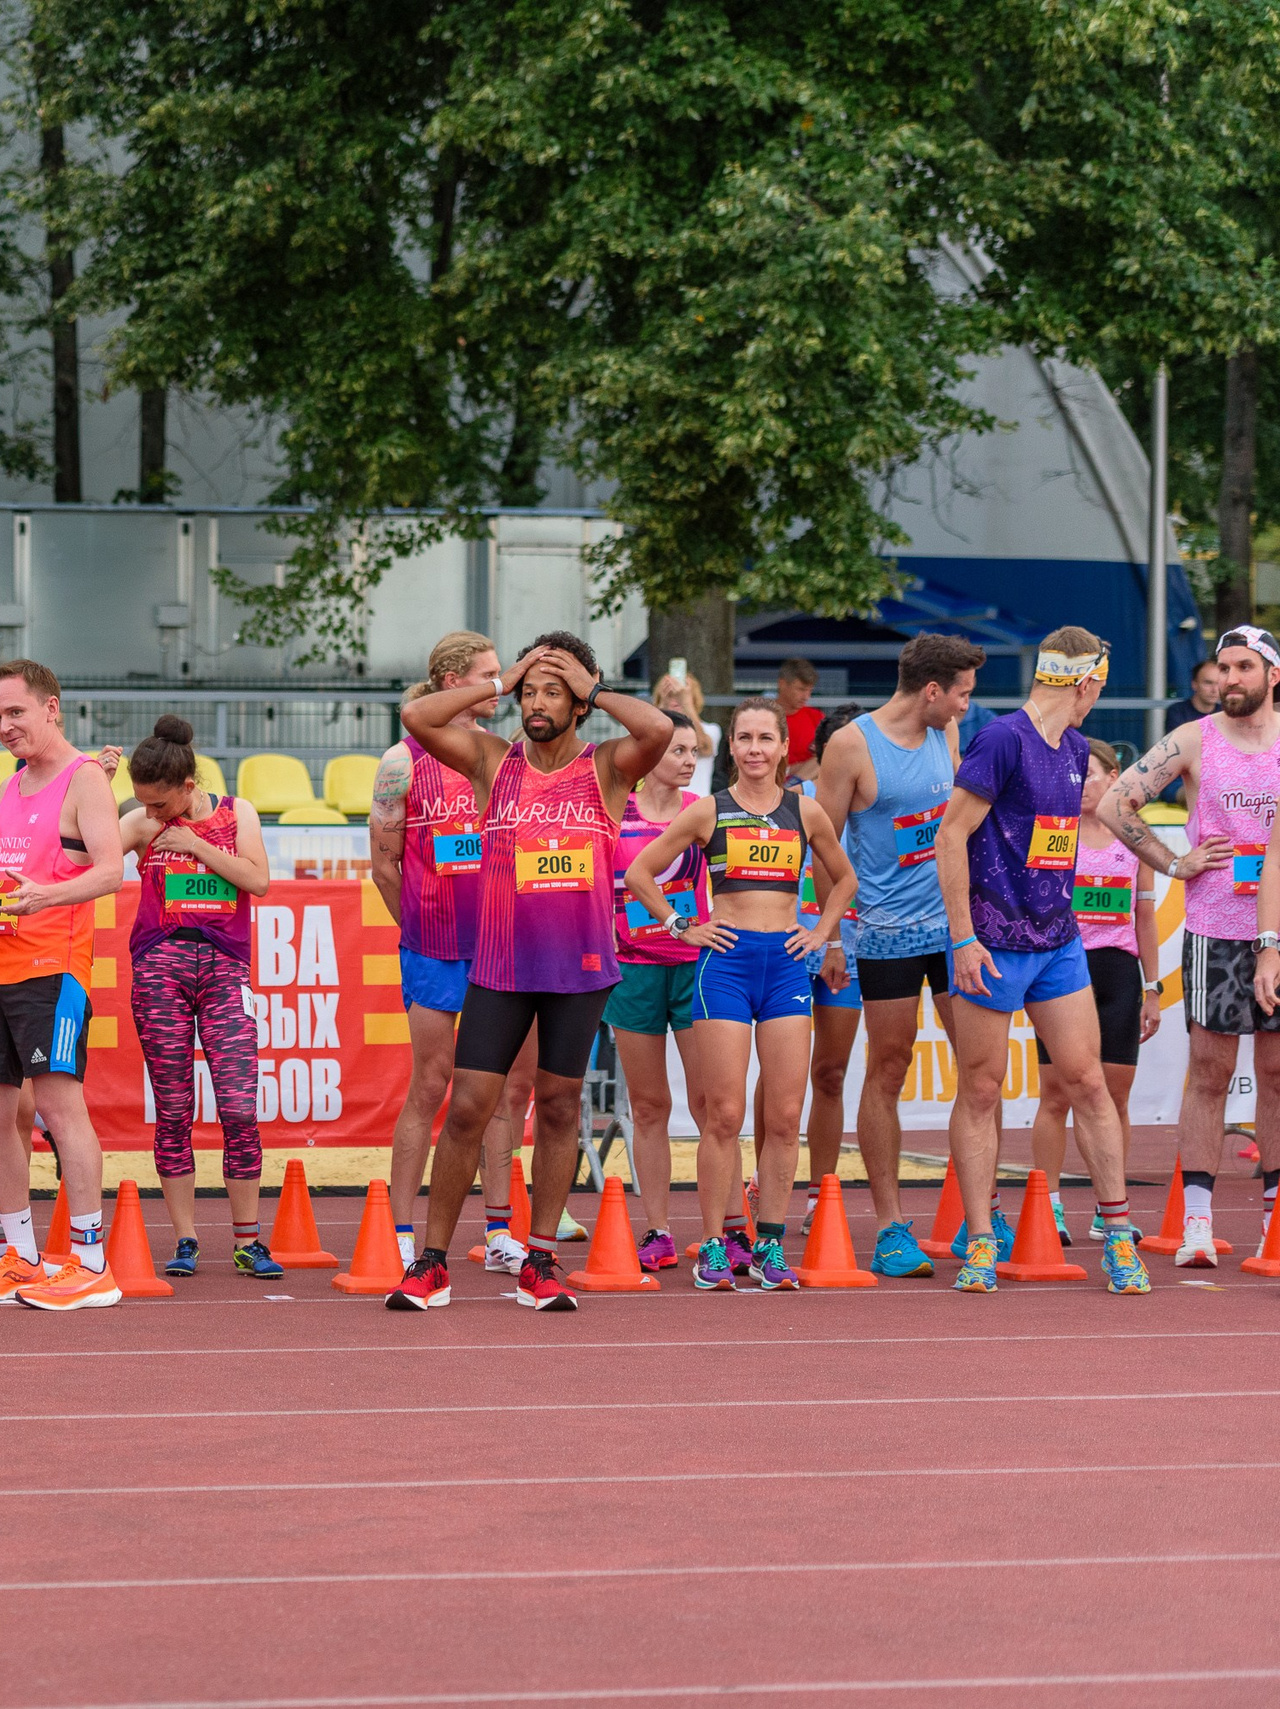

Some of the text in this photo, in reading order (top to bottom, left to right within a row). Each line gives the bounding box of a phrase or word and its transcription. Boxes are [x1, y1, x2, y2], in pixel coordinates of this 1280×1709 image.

[1222, 792, 1274, 814] Magic
[1046, 834, 1069, 852] 209
[749, 845, 793, 864] 207 2
[538, 856, 585, 874] 206 2
[186, 878, 229, 896] 206 4
[684, 904, 690, 912] 3
[1084, 892, 1124, 908] 210 4
